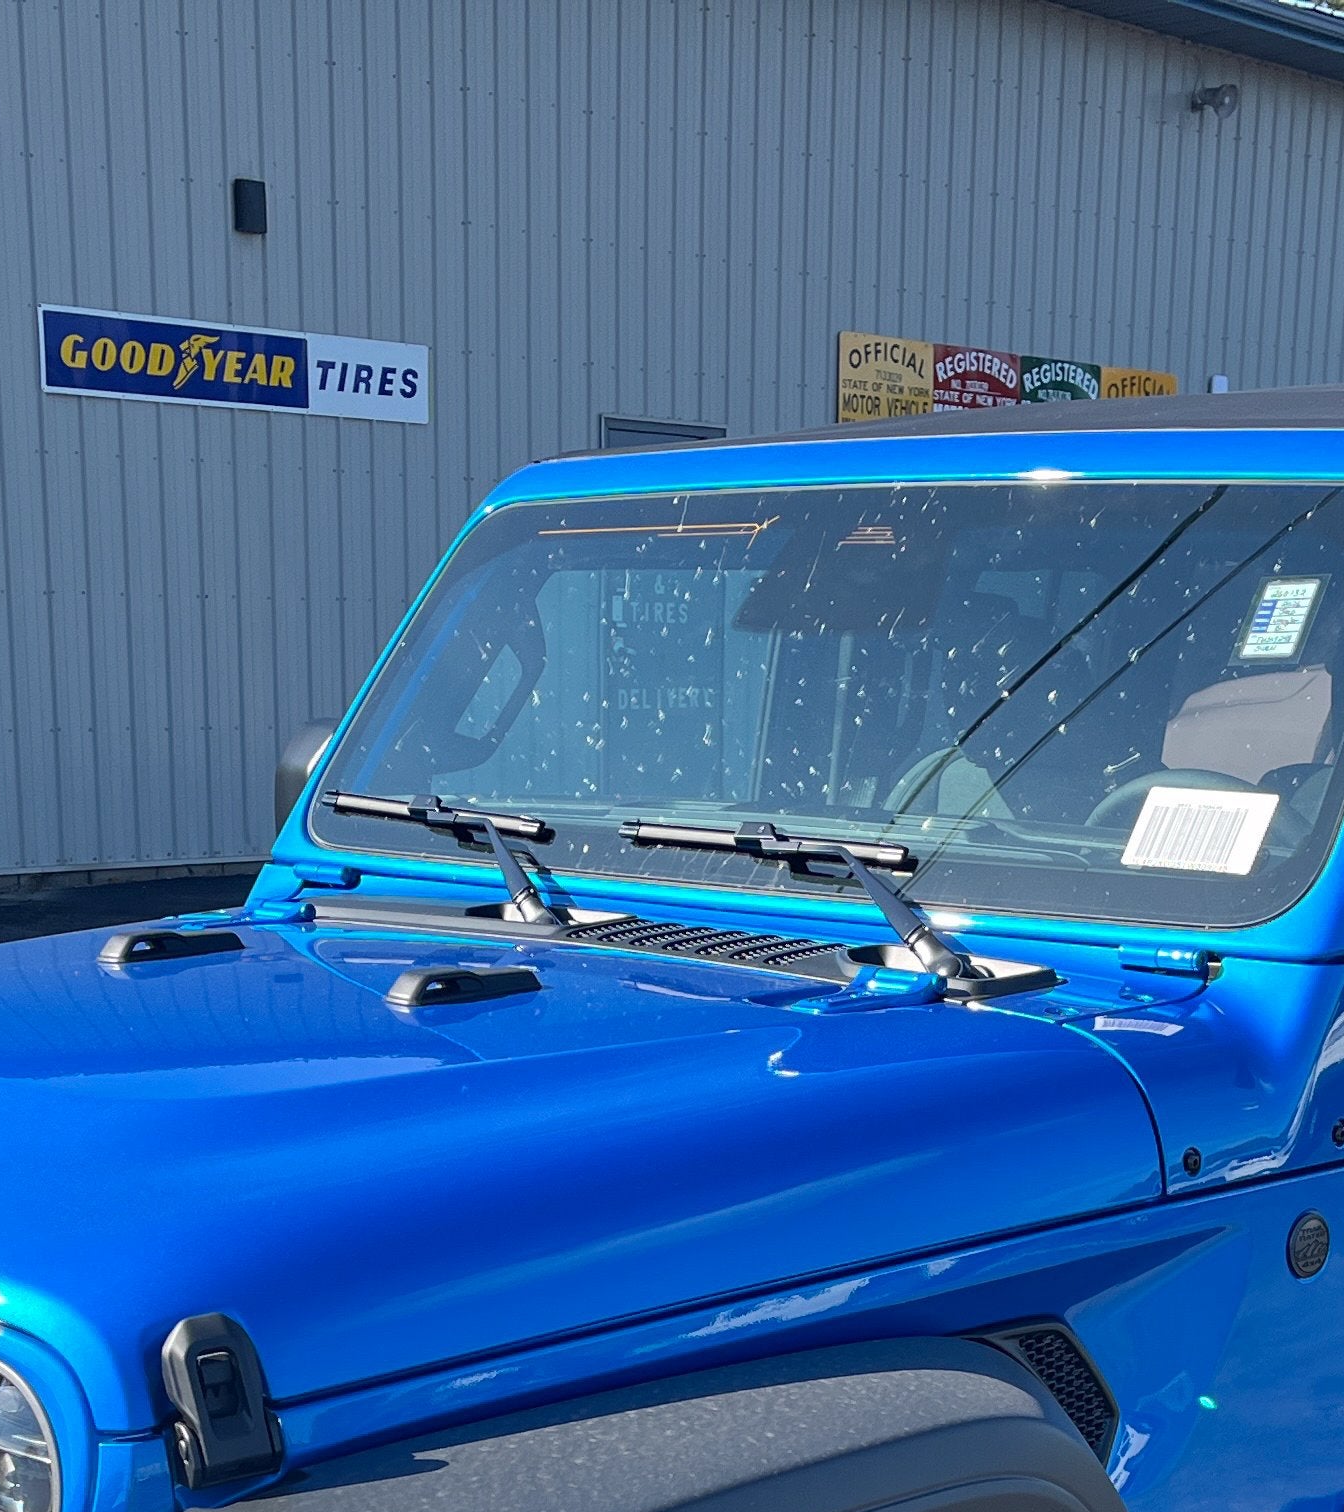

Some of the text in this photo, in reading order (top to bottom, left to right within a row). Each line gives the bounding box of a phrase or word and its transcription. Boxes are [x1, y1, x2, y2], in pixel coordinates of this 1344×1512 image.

[848, 342, 925, 379] OFFICIAL
[935, 351, 1017, 389] REGISTERED
[315, 360, 419, 399] TIRES
[842, 379, 931, 398] STATE OF NEW YORK
[1022, 361, 1099, 400] REGISTERED
[1107, 375, 1171, 399] OFFICIA
[842, 393, 881, 416] MOTOR
[933, 389, 960, 402] STATE
[961, 392, 974, 403] OF
[976, 394, 993, 406] NEW
[630, 602, 689, 624] TIRES
